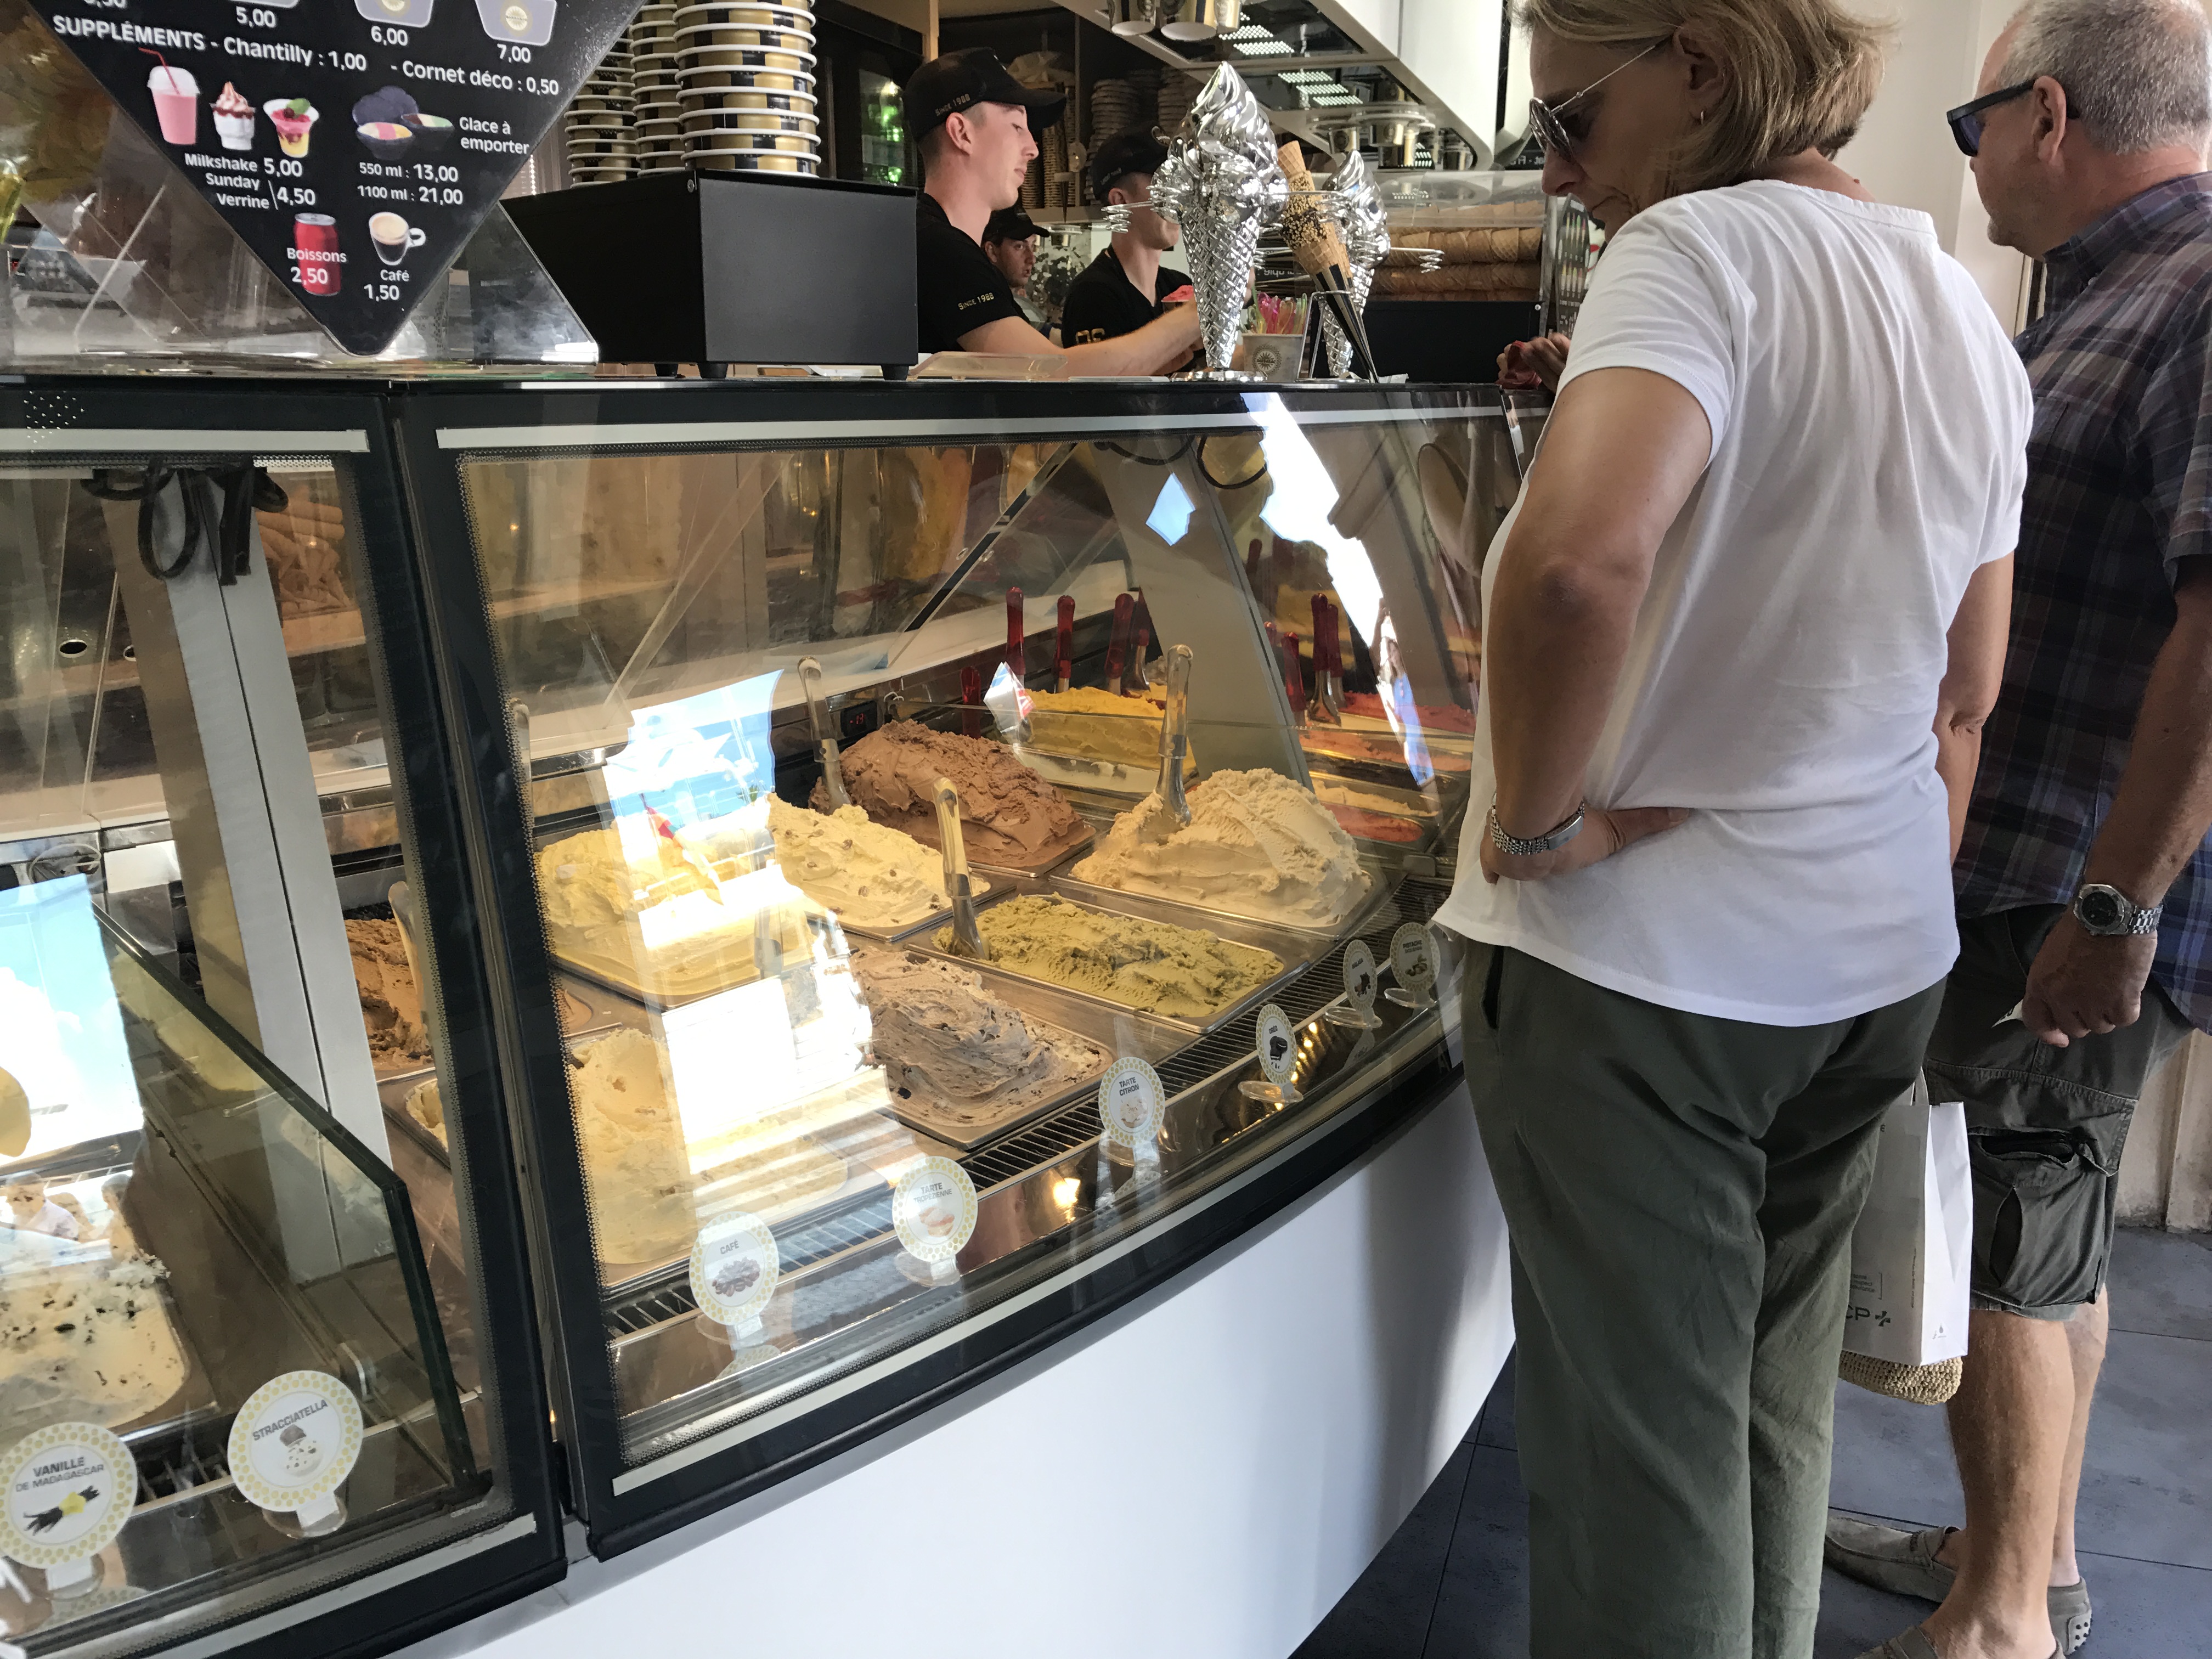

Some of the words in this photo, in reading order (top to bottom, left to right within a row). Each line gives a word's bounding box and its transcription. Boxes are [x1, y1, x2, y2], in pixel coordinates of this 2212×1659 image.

[236, 5, 276, 28] 5,00
[371, 25, 408, 47] 6,00
[53, 14, 206, 50] SUPPLÉMENTS
[224, 36, 313, 66] Chantilly
[328, 50, 366, 71] 1,00
[402, 60, 465, 85] Cornet
[470, 69, 513, 90] déco
[526, 76, 559, 95] 0,50
[497, 43, 531, 64] 7,00
[459, 116, 499, 134] Glace
[502, 120, 511, 135] à
[460, 138, 529, 156] emporter
[185, 153, 257, 172] Milkshake
[264, 157, 302, 178] 5,00
[359, 162, 382, 176] 550
[385, 164, 403, 178] ml
[413, 164, 459, 183] 13,00
[206, 173, 259, 191] Sunday
[217, 193, 269, 209] Verrine
[277, 187, 315, 205] 4,50
[357, 185, 387, 199] 1100
[391, 187, 408, 201] ml
[419, 187, 464, 206] 21,00
[286, 247, 347, 263] Boissons
[290, 267, 329, 285] 2,50
[380, 269, 409, 281] Café
[364, 284, 400, 302] 1,50
[1119, 1077, 1136, 1088] TARTE
[1119, 1084, 1139, 1096] CITRON
[913, 1188, 952, 1203] TROPÉZIENNE
[921, 1182, 943, 1194] TARTE
[720, 1239, 740, 1255] CAFÉ
[253, 1400, 328, 1441] STRACCIATELLA
[33, 1457, 84, 1477] VANILLE
[15, 1482, 29, 1492] DE
[33, 1464, 104, 1487] MADAGASCAR
